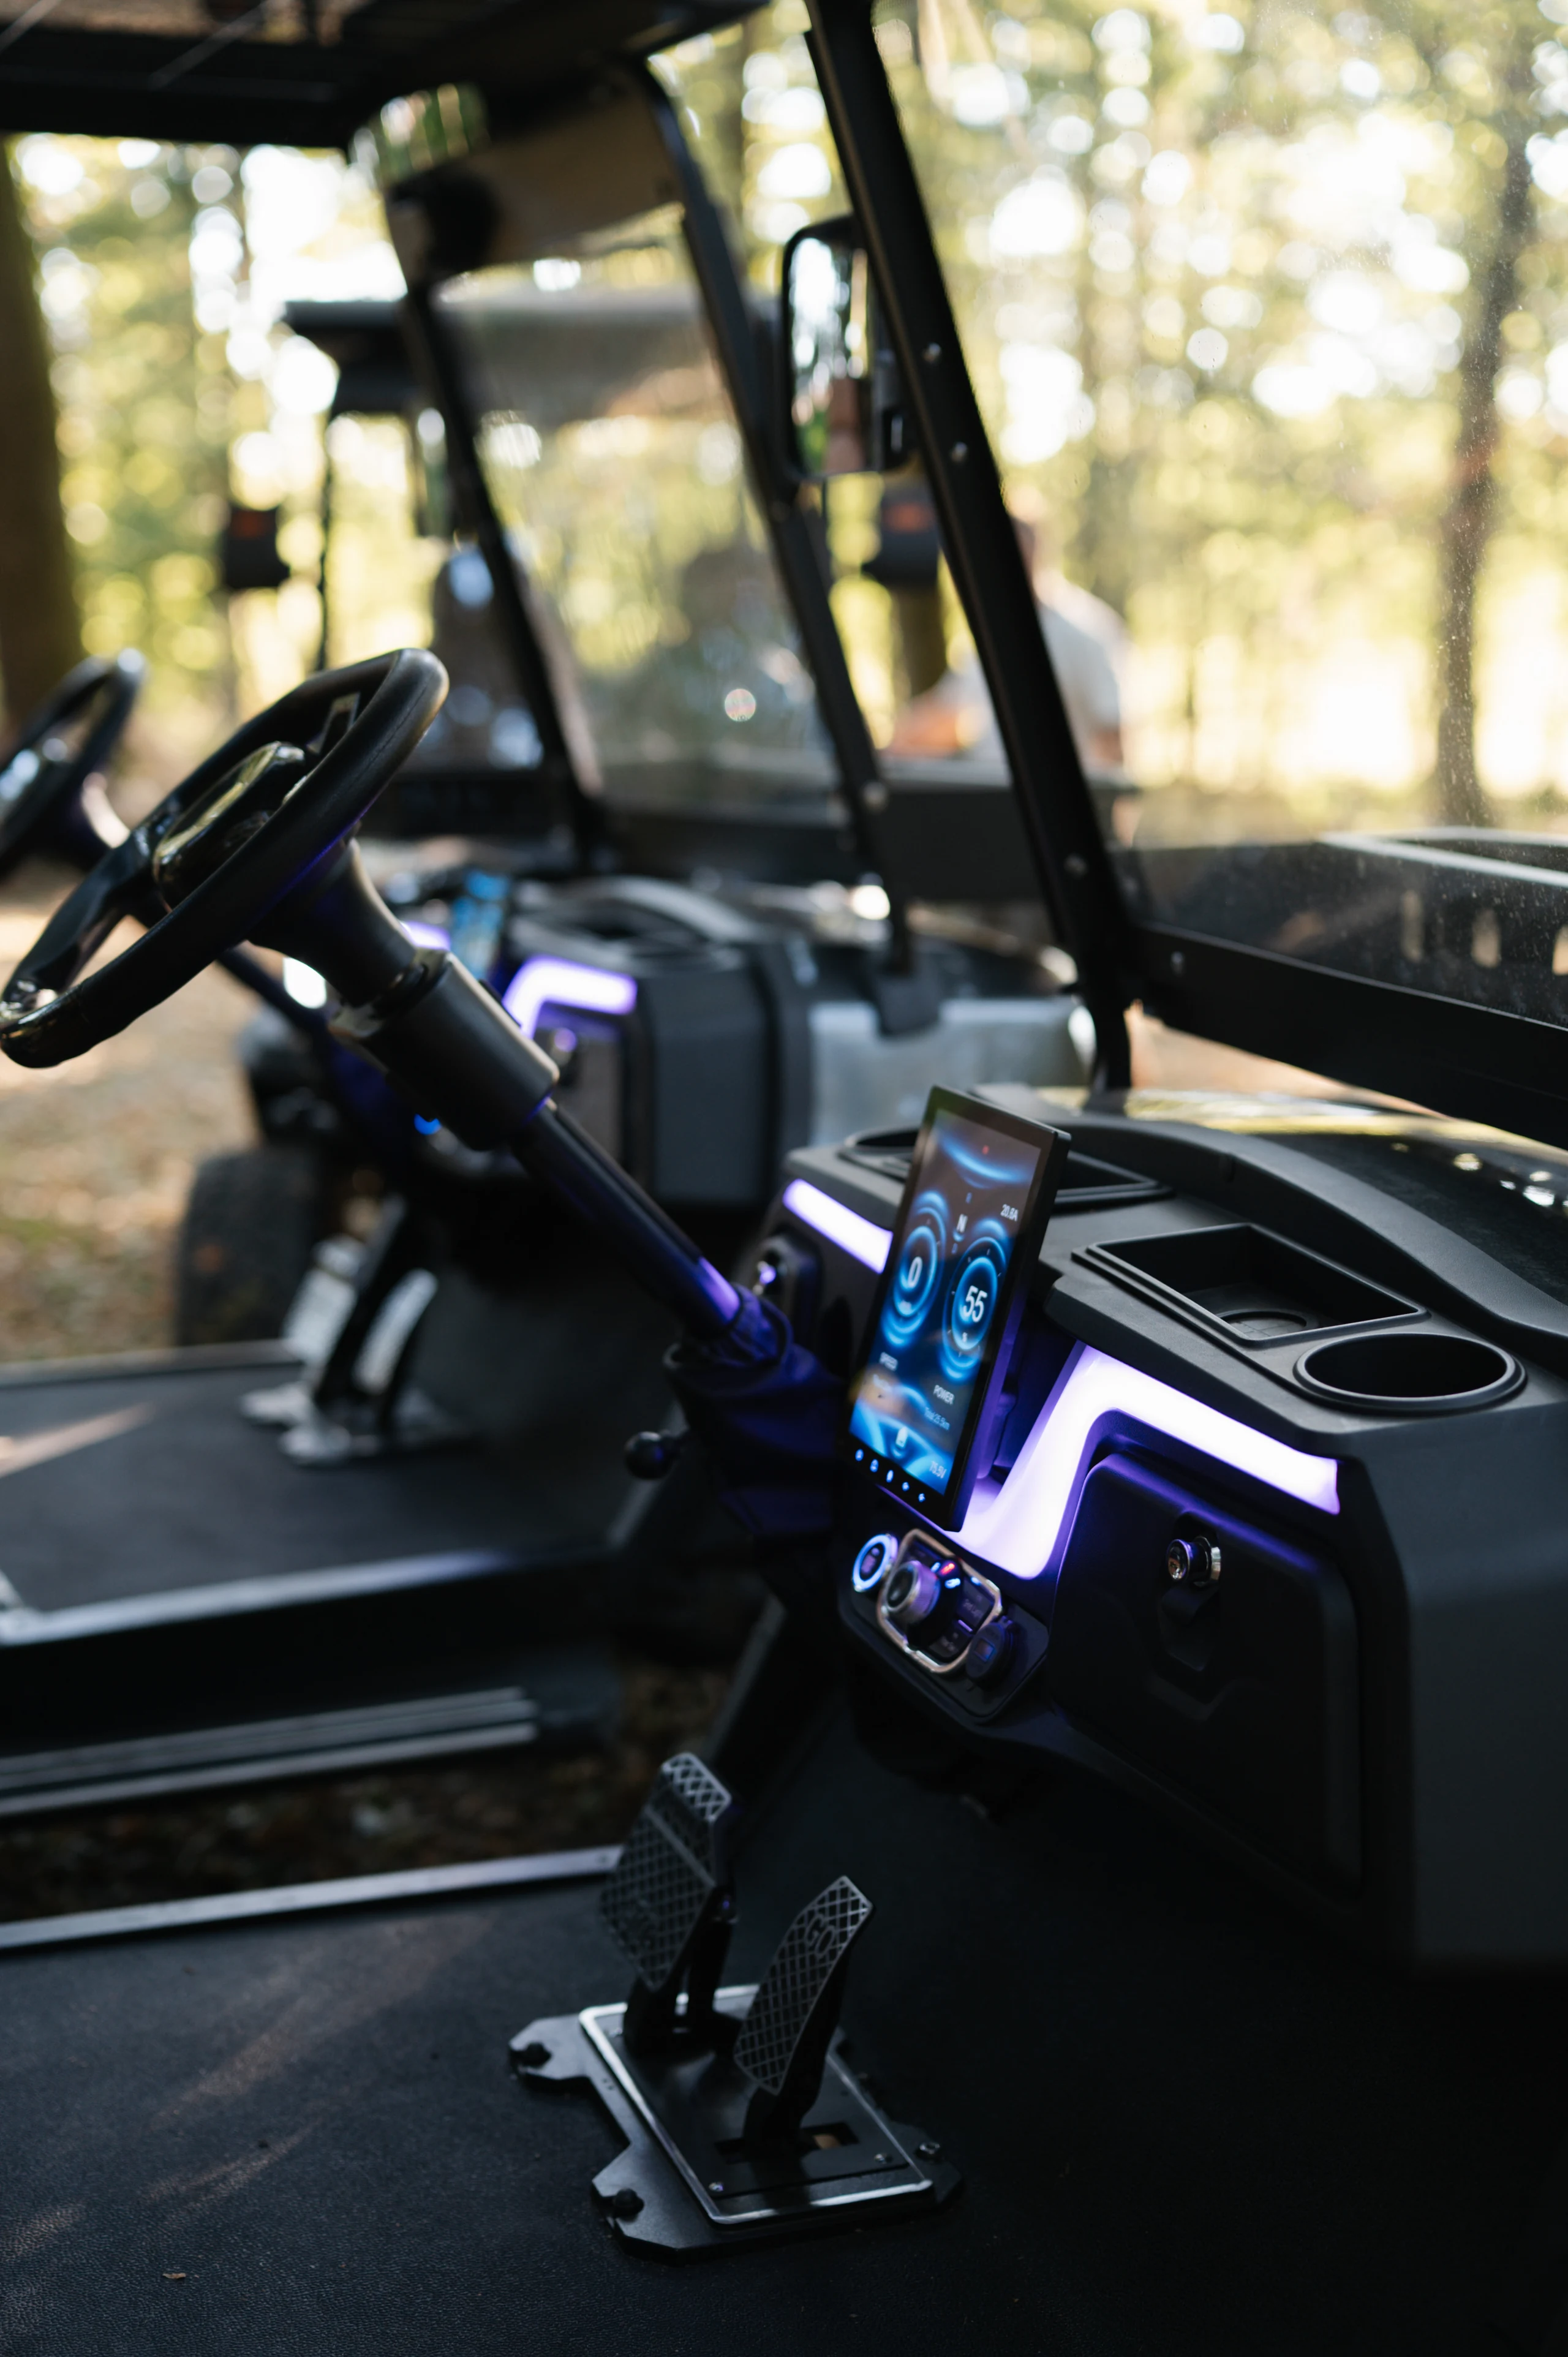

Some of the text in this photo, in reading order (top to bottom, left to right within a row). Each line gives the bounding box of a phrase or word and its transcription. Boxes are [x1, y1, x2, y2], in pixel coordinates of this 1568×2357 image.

[956, 1213, 968, 1233] N
[907, 1256, 922, 1289] 0
[962, 1285, 988, 1322] 55
[933, 1384, 955, 1405] POWER
